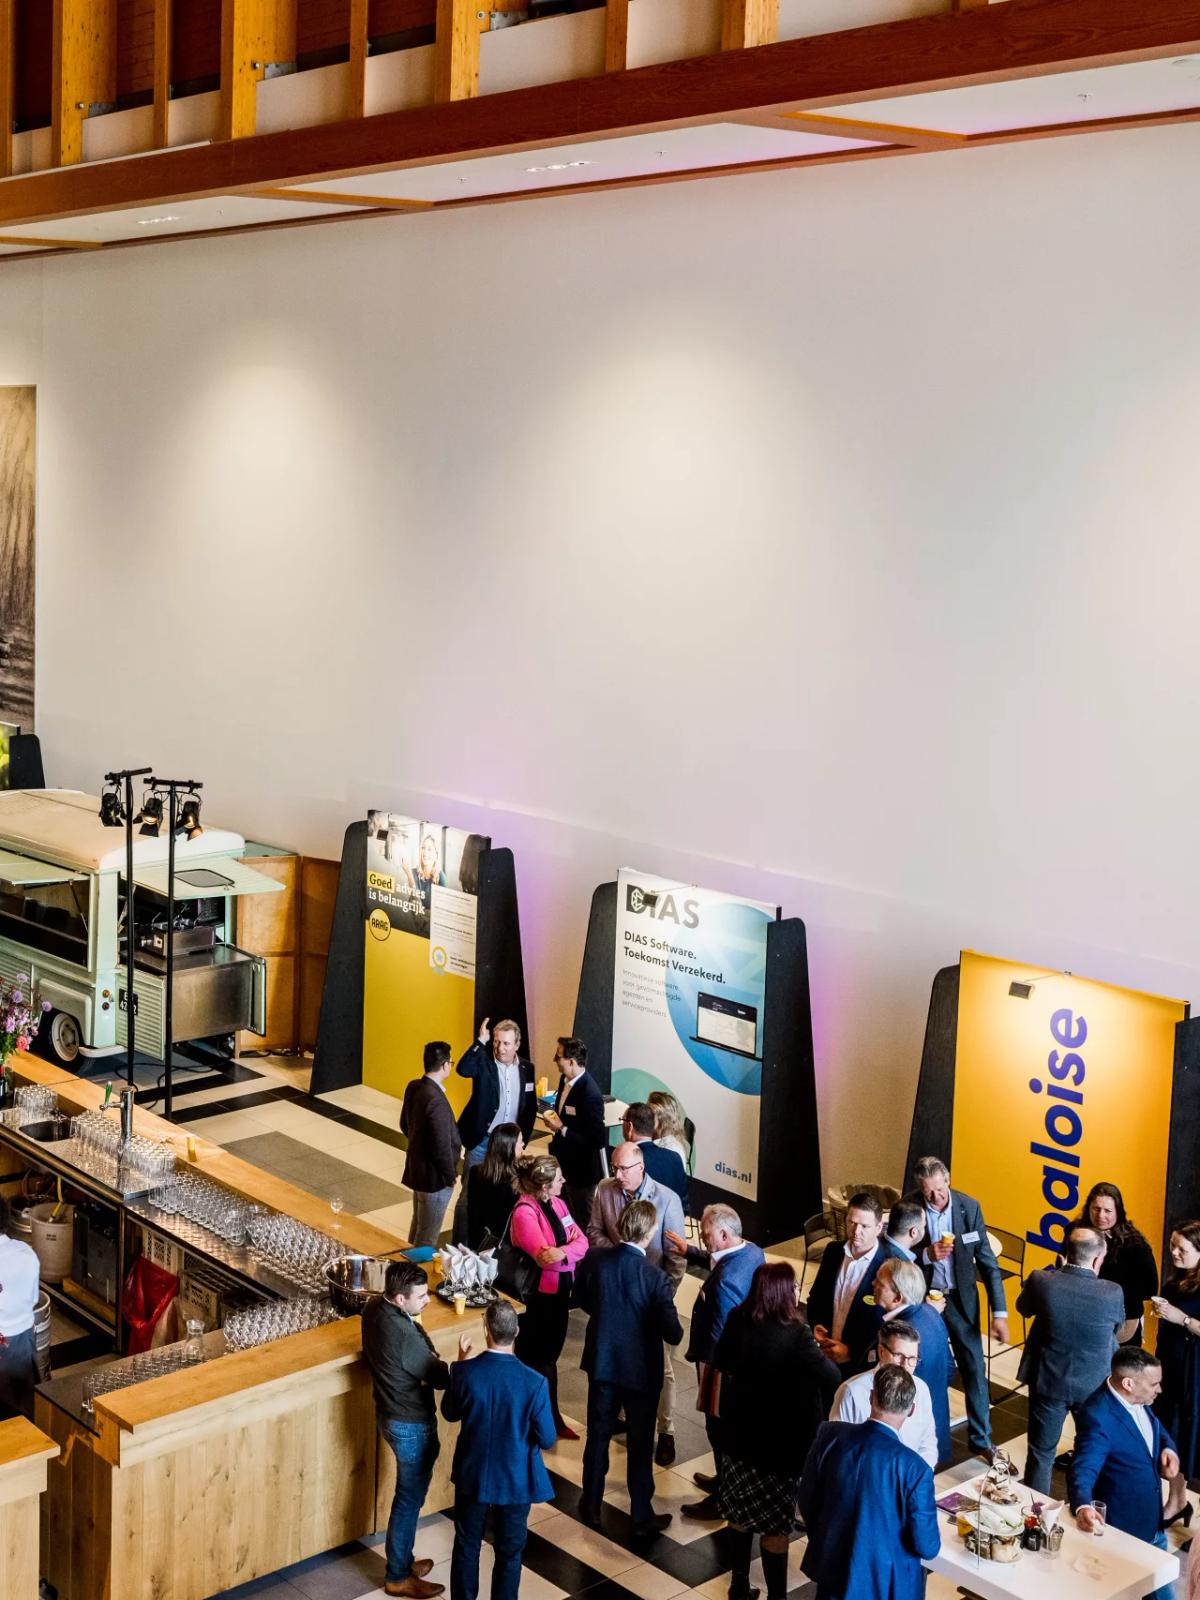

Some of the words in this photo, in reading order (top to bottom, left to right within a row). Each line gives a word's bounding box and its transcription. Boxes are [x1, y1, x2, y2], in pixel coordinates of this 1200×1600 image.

[369, 873, 392, 889] Goed
[396, 883, 425, 899] advies
[368, 888, 376, 900] is
[378, 890, 425, 915] belangrijk
[371, 918, 388, 931] ARAG
[624, 930, 647, 945] DIAS
[650, 938, 697, 959] Software.
[624, 946, 669, 968] Toekomst
[672, 960, 726, 984] Verzekerd.
[1026, 1008, 1088, 1254] baloise
[714, 1161, 752, 1184] dias.nl
